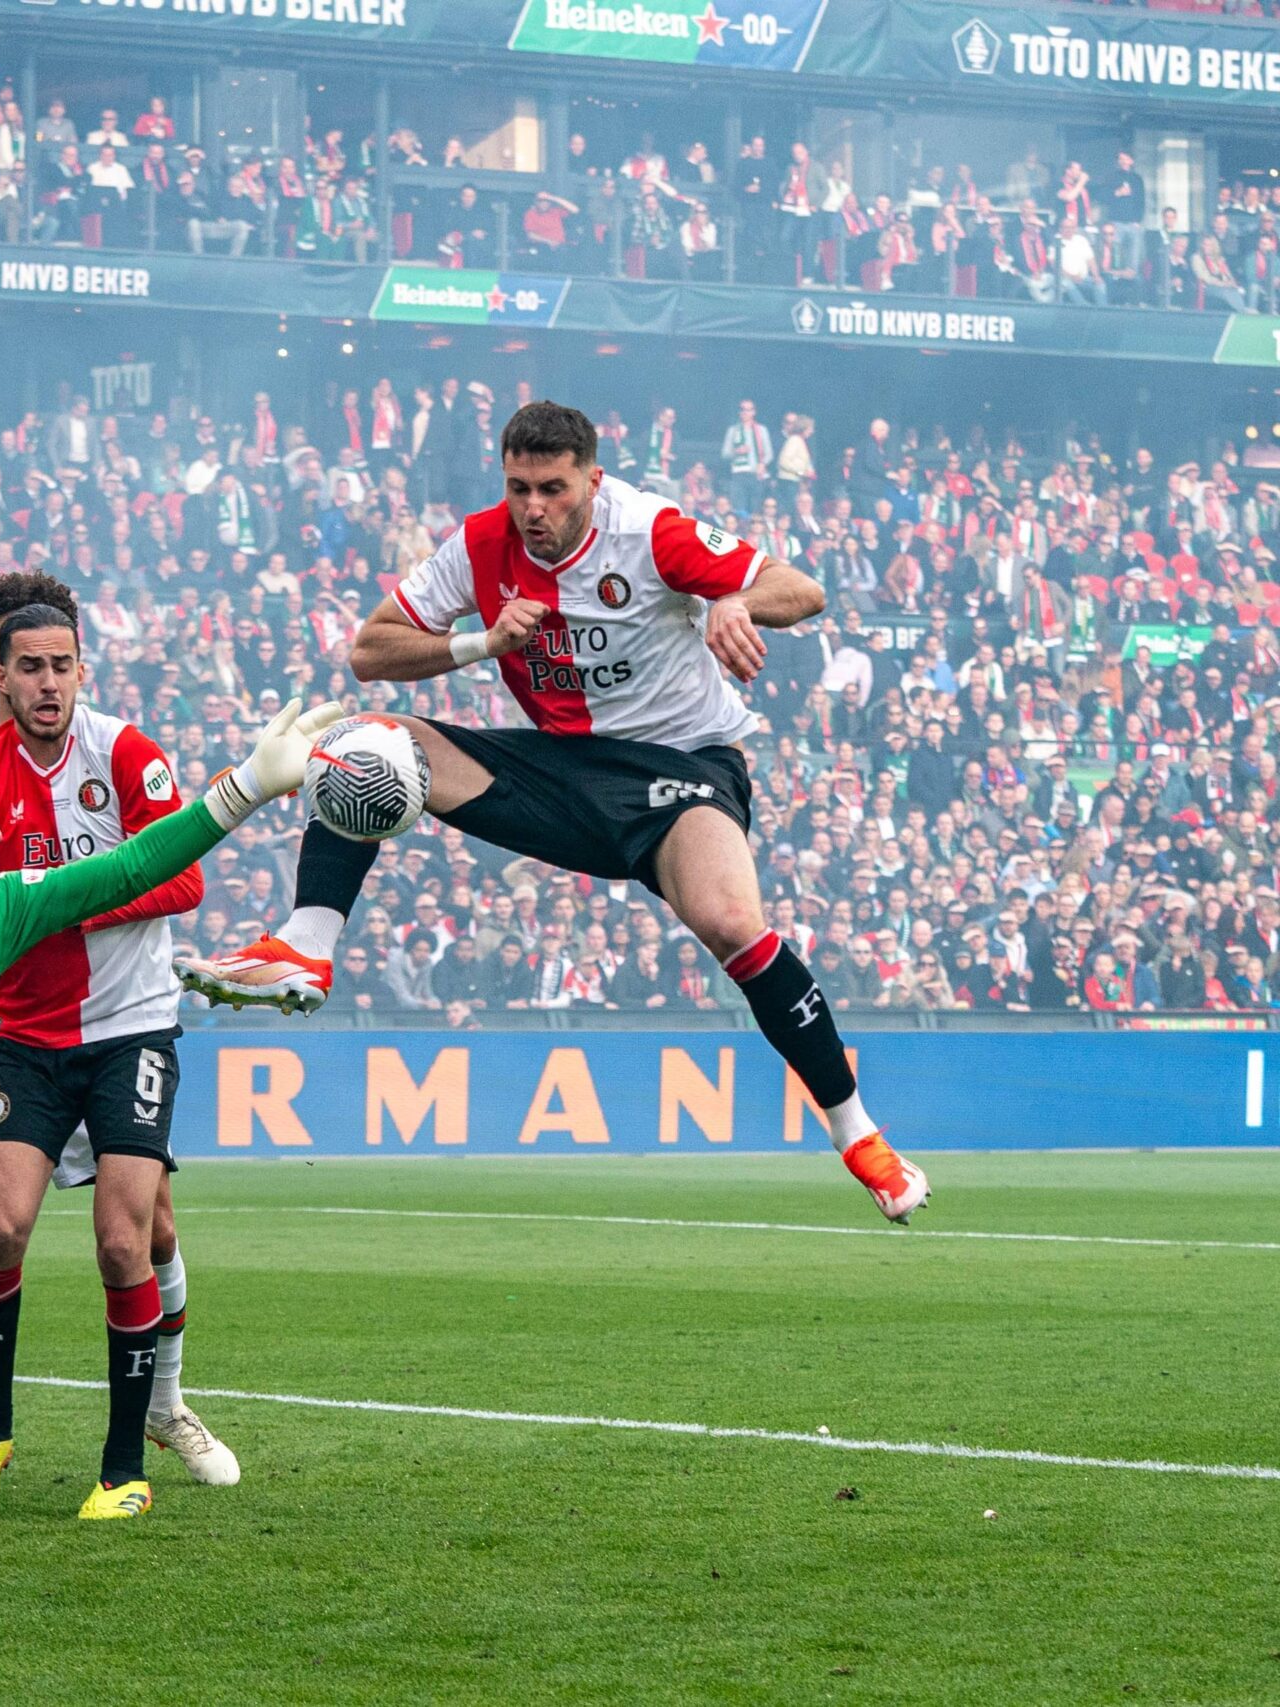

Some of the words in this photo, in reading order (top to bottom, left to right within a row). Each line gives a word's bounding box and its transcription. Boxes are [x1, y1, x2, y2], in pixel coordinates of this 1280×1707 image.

[545, 0, 691, 38] Heineken
[1009, 30, 1090, 79] TOTO
[1097, 39, 1192, 86] KNVB
[1, 262, 68, 292] KNVB
[73, 265, 151, 297] BEKER
[392, 282, 485, 308] Heineken
[826, 303, 878, 336] TOTO
[881, 309, 942, 339] KNVB
[945, 312, 1016, 343] BEKER
[527, 659, 632, 692] Parcs
[146, 767, 170, 795] TOTO
[22, 831, 96, 867] Euro
[789, 981, 821, 1028] F
[136, 1047, 166, 1105] 6
[125, 1347, 156, 1378] F
